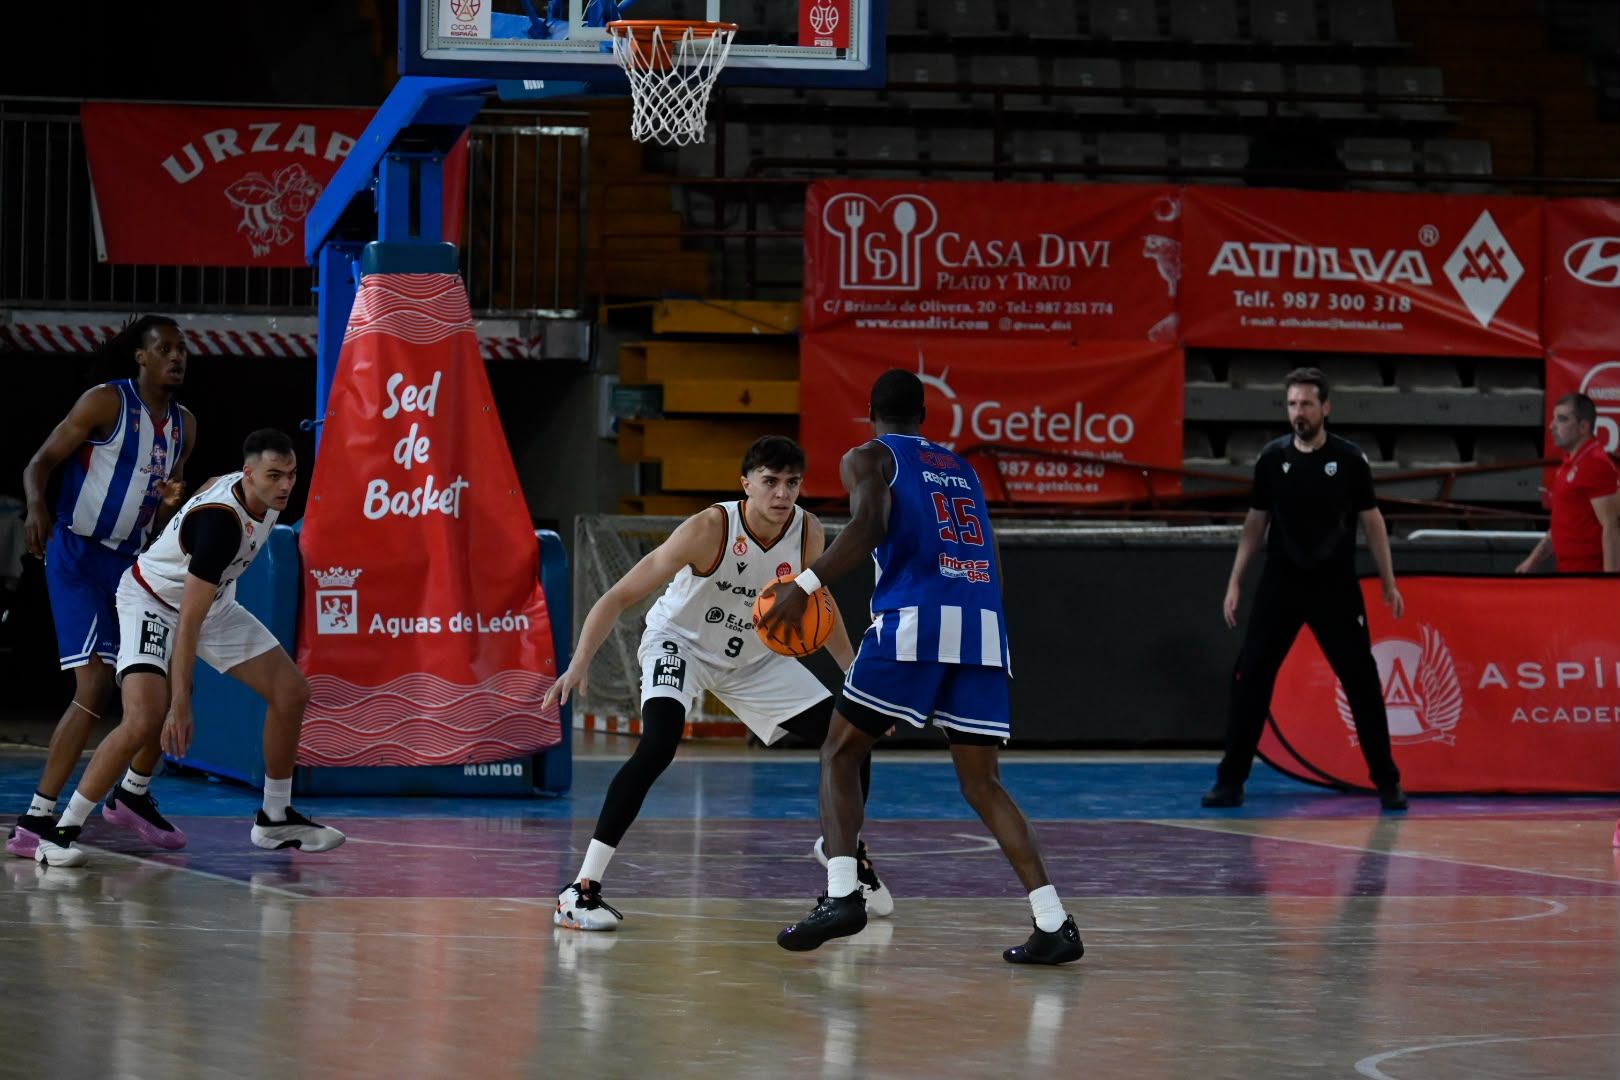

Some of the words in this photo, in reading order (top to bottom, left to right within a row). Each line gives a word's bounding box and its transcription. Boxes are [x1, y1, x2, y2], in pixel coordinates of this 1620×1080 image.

[161, 121, 358, 185] URZAP
[935, 231, 1026, 269] CASA
[1036, 232, 1111, 269] DIVI
[936, 271, 991, 291] PLATO
[996, 274, 1008, 291] Y
[1012, 271, 1072, 291] TRATO
[899, 300, 917, 313] de
[977, 300, 997, 314] 20
[1034, 301, 1060, 315] 987
[1233, 289, 1276, 309] Telf.
[1282, 291, 1320, 310] 987
[1327, 292, 1366, 311] 300
[382, 370, 442, 420] Sed
[970, 401, 1135, 444] Getelco
[393, 422, 431, 470] de
[1034, 461, 1068, 478] 620
[363, 474, 469, 520] Basket
[368, 613, 442, 639] Aguas
[449, 611, 473, 633] de
[477, 609, 529, 633] León
[724, 636, 745, 658] 9
[660, 655, 681, 668] BUN
[657, 674, 680, 688] HAM
[463, 763, 524, 777] MONDO
